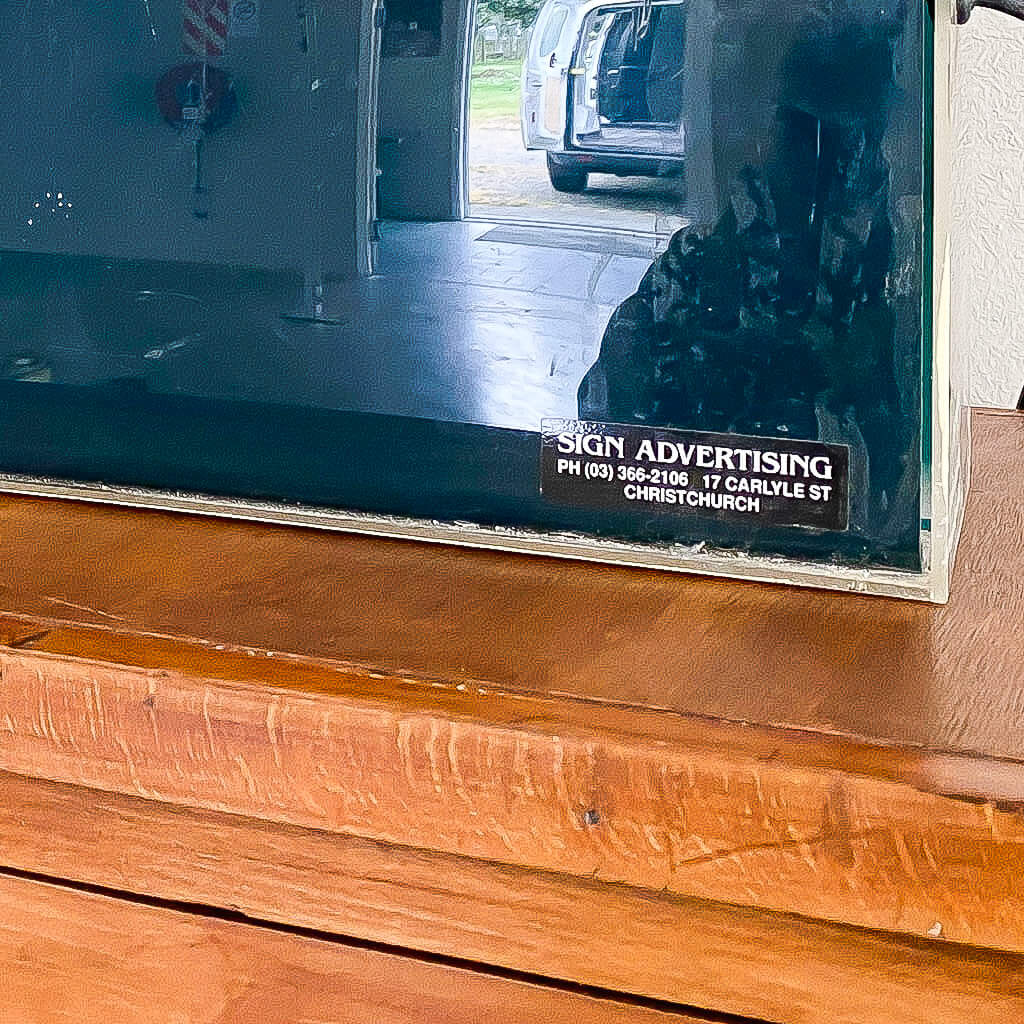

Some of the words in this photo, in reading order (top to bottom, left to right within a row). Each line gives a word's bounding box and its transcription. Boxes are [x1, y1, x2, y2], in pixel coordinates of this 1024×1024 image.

[557, 432, 625, 458] SIGN
[635, 439, 833, 479] ADVERTISING
[557, 459, 581, 475] PH
[584, 462, 614, 481] (03)
[617, 465, 689, 487] 366-2106
[702, 475, 721, 490] 17
[725, 476, 805, 499] CARLYLE
[809, 484, 832, 501] ST
[624, 484, 760, 513] CHRISTCHURCH
